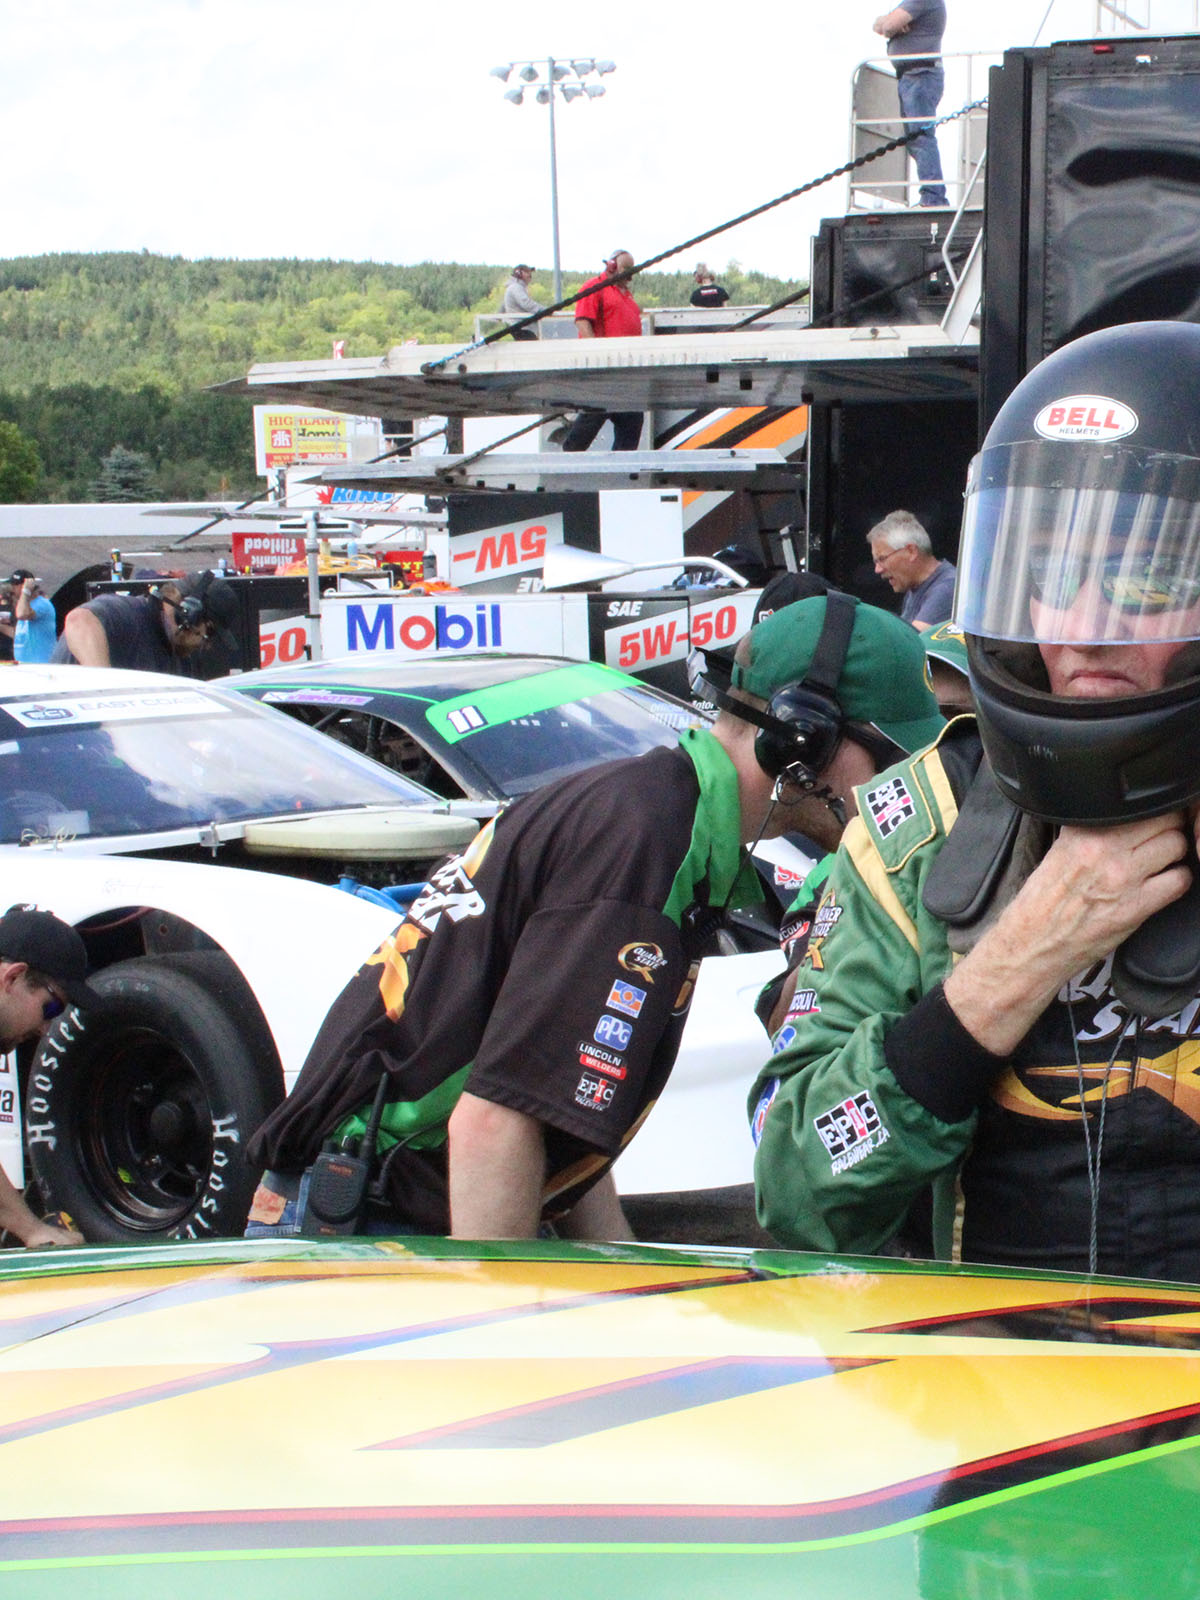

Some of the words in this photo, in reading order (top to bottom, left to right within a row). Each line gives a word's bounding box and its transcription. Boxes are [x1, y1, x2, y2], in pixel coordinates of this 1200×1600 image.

[1047, 406, 1121, 430] BELL
[1058, 427, 1101, 437] HELMETS
[244, 537, 298, 554] Tiltload
[606, 601, 643, 617] SAE
[346, 603, 501, 651] Mobil
[619, 605, 737, 668] 5W-50
[447, 705, 486, 734] 11
[633, 947, 668, 967] QUAKER
[598, 1016, 631, 1044] PPG
[579, 1042, 622, 1067] LINCOLN
[585, 1057, 622, 1077] WELDERS
[577, 1077, 614, 1101] EPIC
[817, 1097, 881, 1152] EPIC
